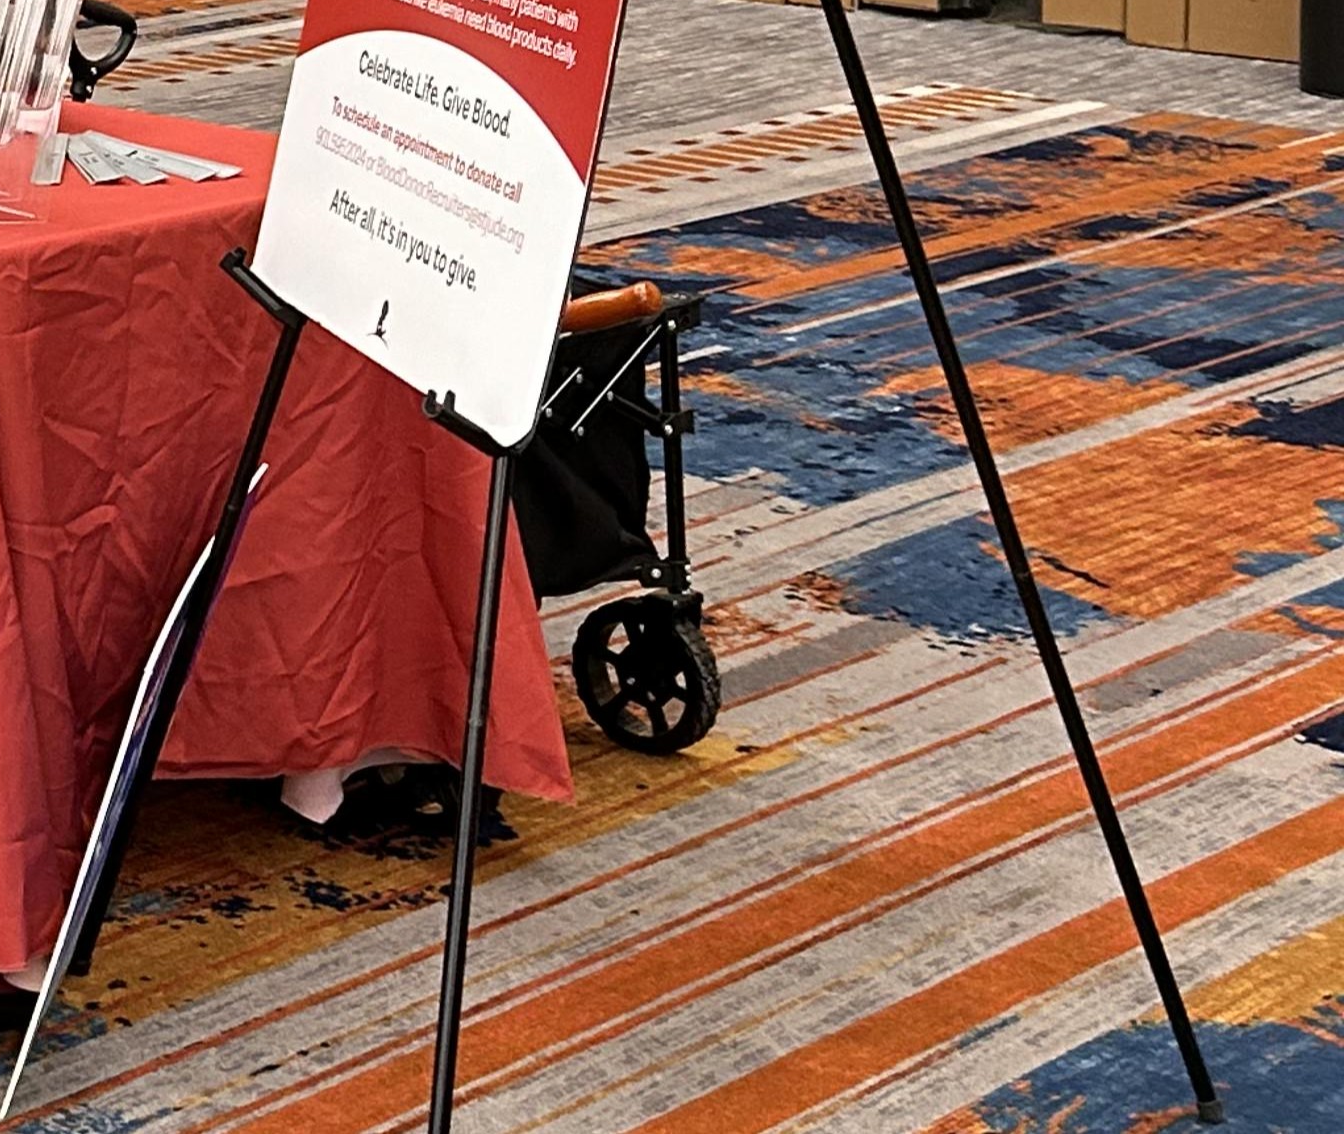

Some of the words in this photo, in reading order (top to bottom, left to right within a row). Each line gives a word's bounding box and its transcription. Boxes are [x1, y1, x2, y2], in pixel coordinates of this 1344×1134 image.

[463, 10, 489, 32] need
[485, 13, 515, 41] blood
[510, 27, 553, 56] products
[556, 8, 579, 32] with
[359, 50, 413, 95] Celebrate
[414, 72, 440, 107] Life.
[442, 85, 471, 119] Give
[471, 97, 511, 139] Blood.
[331, 96, 343, 117] To
[342, 104, 381, 136] schedule
[380, 123, 393, 142] an
[393, 129, 454, 171] appointment
[454, 154, 466, 176] to
[466, 160, 502, 194] donate
[502, 180, 524, 203] call
[329, 188, 361, 226] After
[359, 205, 376, 239] all,
[376, 210, 396, 244] it's
[395, 220, 408, 254] in
[406, 236, 432, 265] you
[433, 244, 448, 273] to
[447, 254, 477, 291] give.
